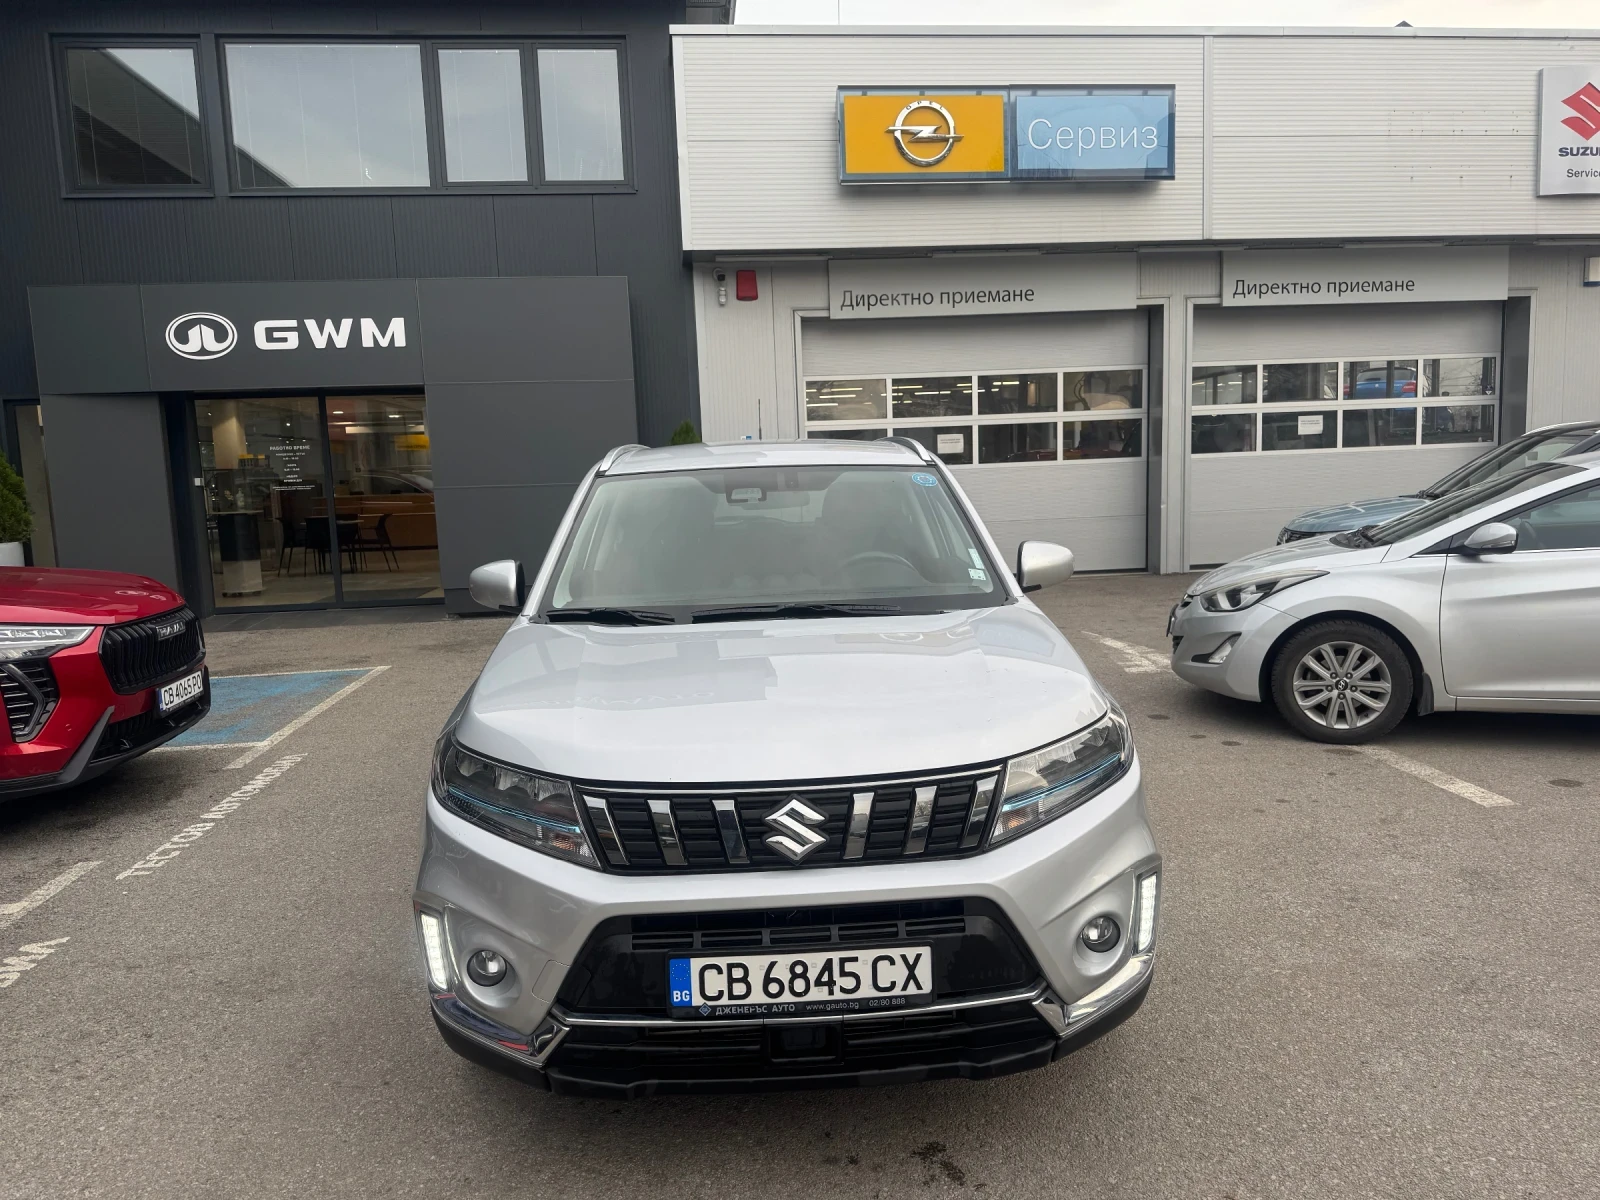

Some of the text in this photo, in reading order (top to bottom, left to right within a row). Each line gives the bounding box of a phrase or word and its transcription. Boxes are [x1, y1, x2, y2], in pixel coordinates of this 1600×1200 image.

[906, 100, 945, 111] OPEL
[1027, 118, 1158, 157] Сервиз
[1558, 146, 1600, 157] SUZU
[1566, 168, 1600, 178] Servic
[1233, 279, 1415, 299] Директно приемане
[840, 288, 1035, 311] Директно приемане
[253, 317, 406, 350] GWM
[163, 687, 174, 707] CB
[175, 679, 192, 701] 4065
[192, 674, 201, 693] PO
[115, 822, 215, 880] ТЕСТОВ
[698, 953, 923, 1002] CB 6845 CX
[673, 990, 690, 1002] BG
[806, 1002, 859, 1010] www.gauto.bg
[772, 1004, 795, 1013] АУТО
